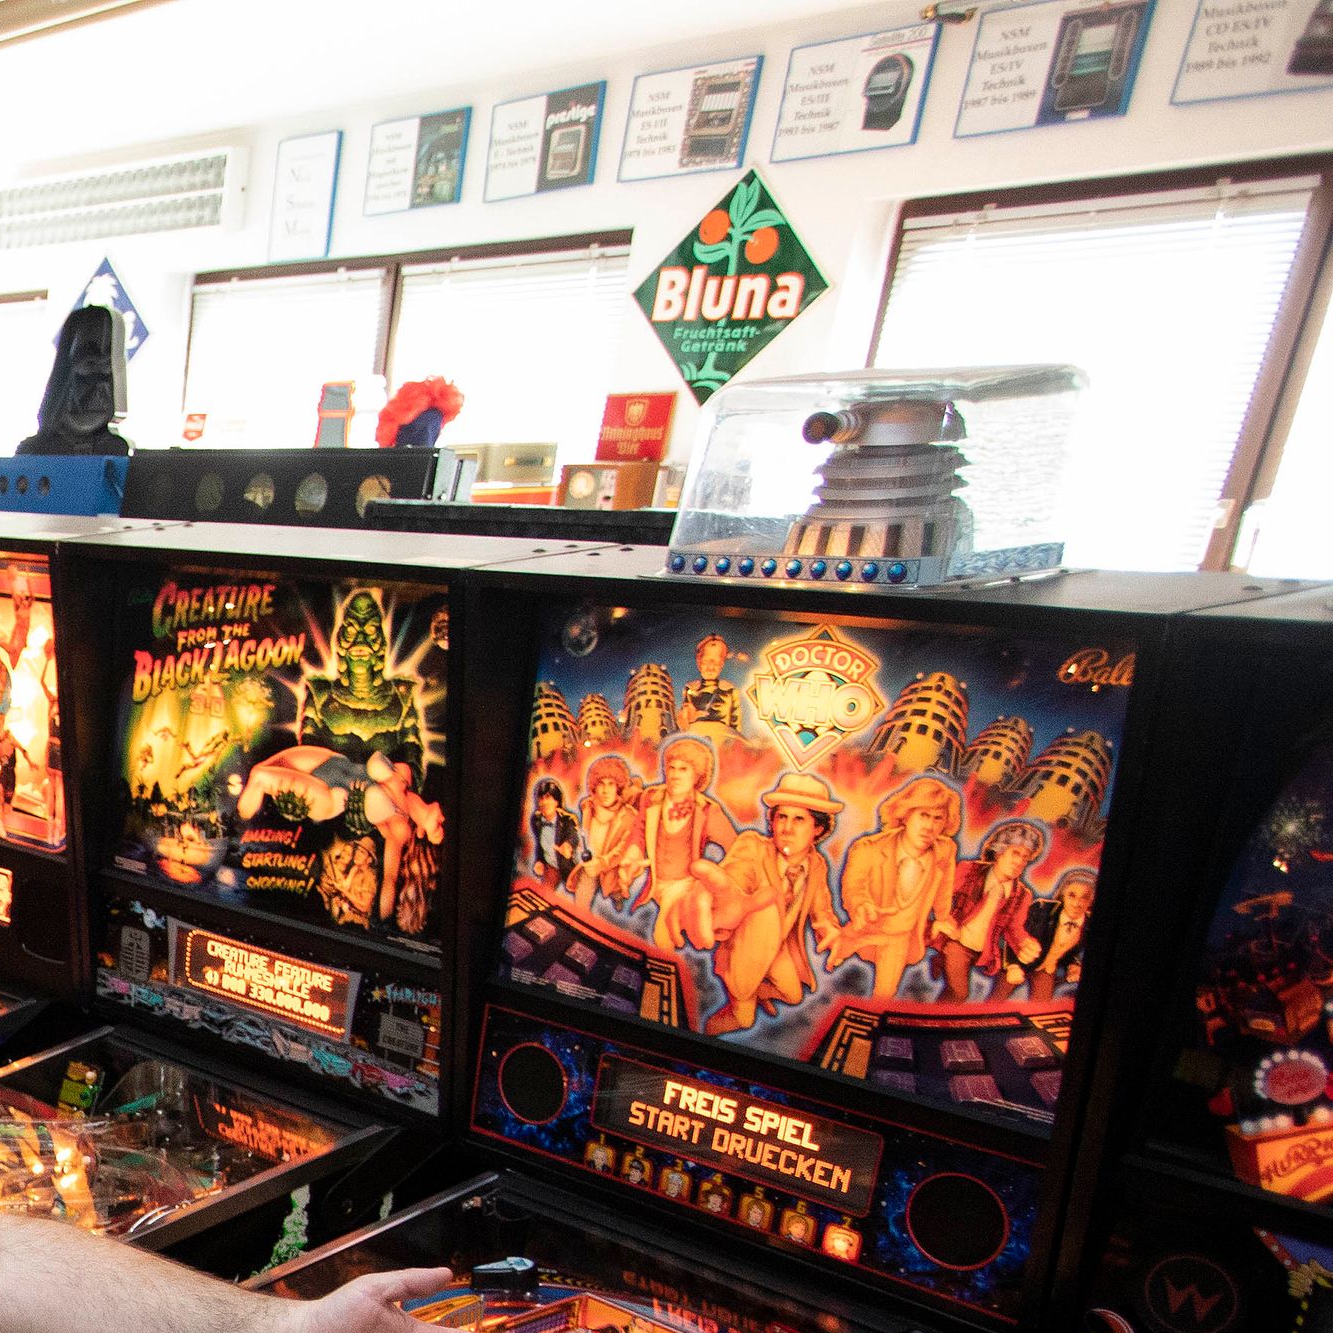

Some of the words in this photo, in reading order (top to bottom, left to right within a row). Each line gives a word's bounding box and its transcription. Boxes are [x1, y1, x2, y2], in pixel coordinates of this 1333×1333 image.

[546, 100, 597, 130] prestige
[652, 267, 805, 322] Bluna
[672, 324, 761, 342] Fruchtsaft-
[679, 338, 748, 354] Getränk
[153, 581, 277, 638] CREATURE
[177, 626, 218, 651] FROM
[221, 623, 251, 640] THE
[133, 649, 209, 702] BLACK
[208, 632, 306, 686] LAGOON
[775, 644, 867, 681] DOCTOR
[757, 674, 875, 726] WHO
[240, 826, 303, 848] AMAZING!
[242, 853, 317, 875] STARTLING!
[207, 940, 269, 969] CREATURE
[274, 960, 333, 993] FEATURE
[662, 1080, 736, 1125] FREIS
[743, 1105, 820, 1152] SPIEL
[629, 1101, 704, 1146] START
[712, 1125, 851, 1193] DRUECKEN
